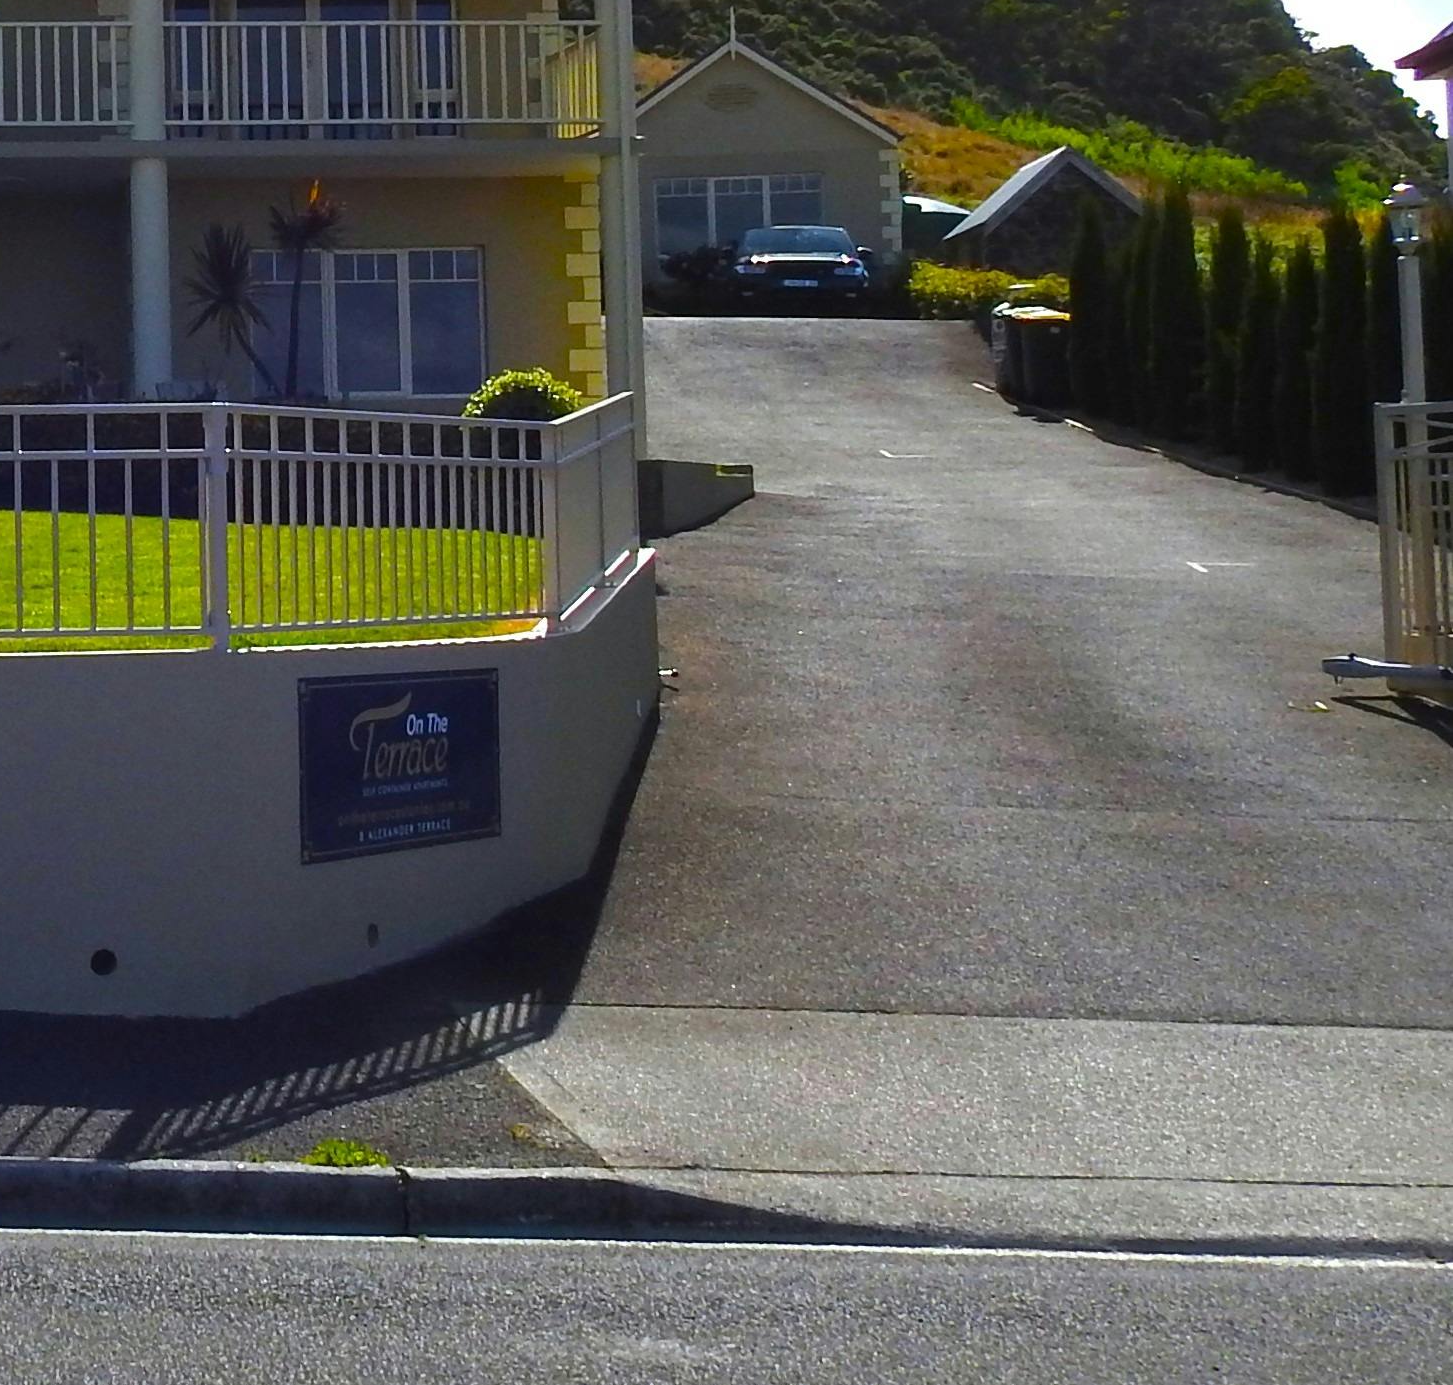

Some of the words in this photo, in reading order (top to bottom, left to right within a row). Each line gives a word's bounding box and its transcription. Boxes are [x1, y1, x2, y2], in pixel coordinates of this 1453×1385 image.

[349, 690, 449, 780] Terrace
[406, 713, 424, 736] On
[426, 712, 449, 734] The
[367, 823, 414, 841] ALEXANDER
[416, 815, 452, 833] TERRACE
